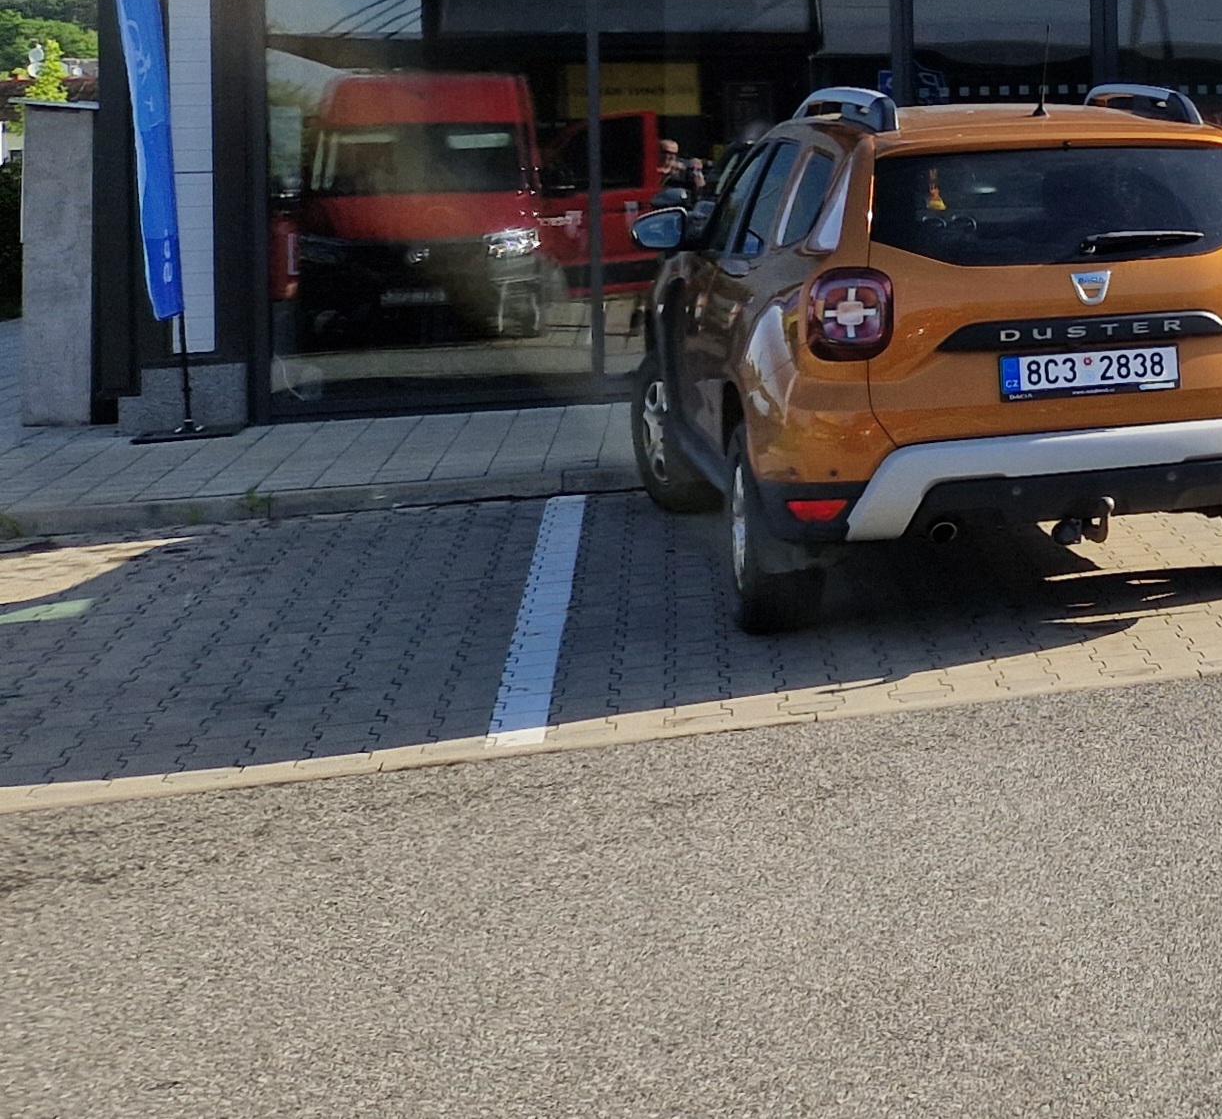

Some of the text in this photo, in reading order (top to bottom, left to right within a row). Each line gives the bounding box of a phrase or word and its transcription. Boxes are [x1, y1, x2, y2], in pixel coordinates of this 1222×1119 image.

[1000, 319, 1182, 342] DUSTER
[1026, 351, 1165, 386] 8C3 2838
[1005, 378, 1019, 389] CZ
